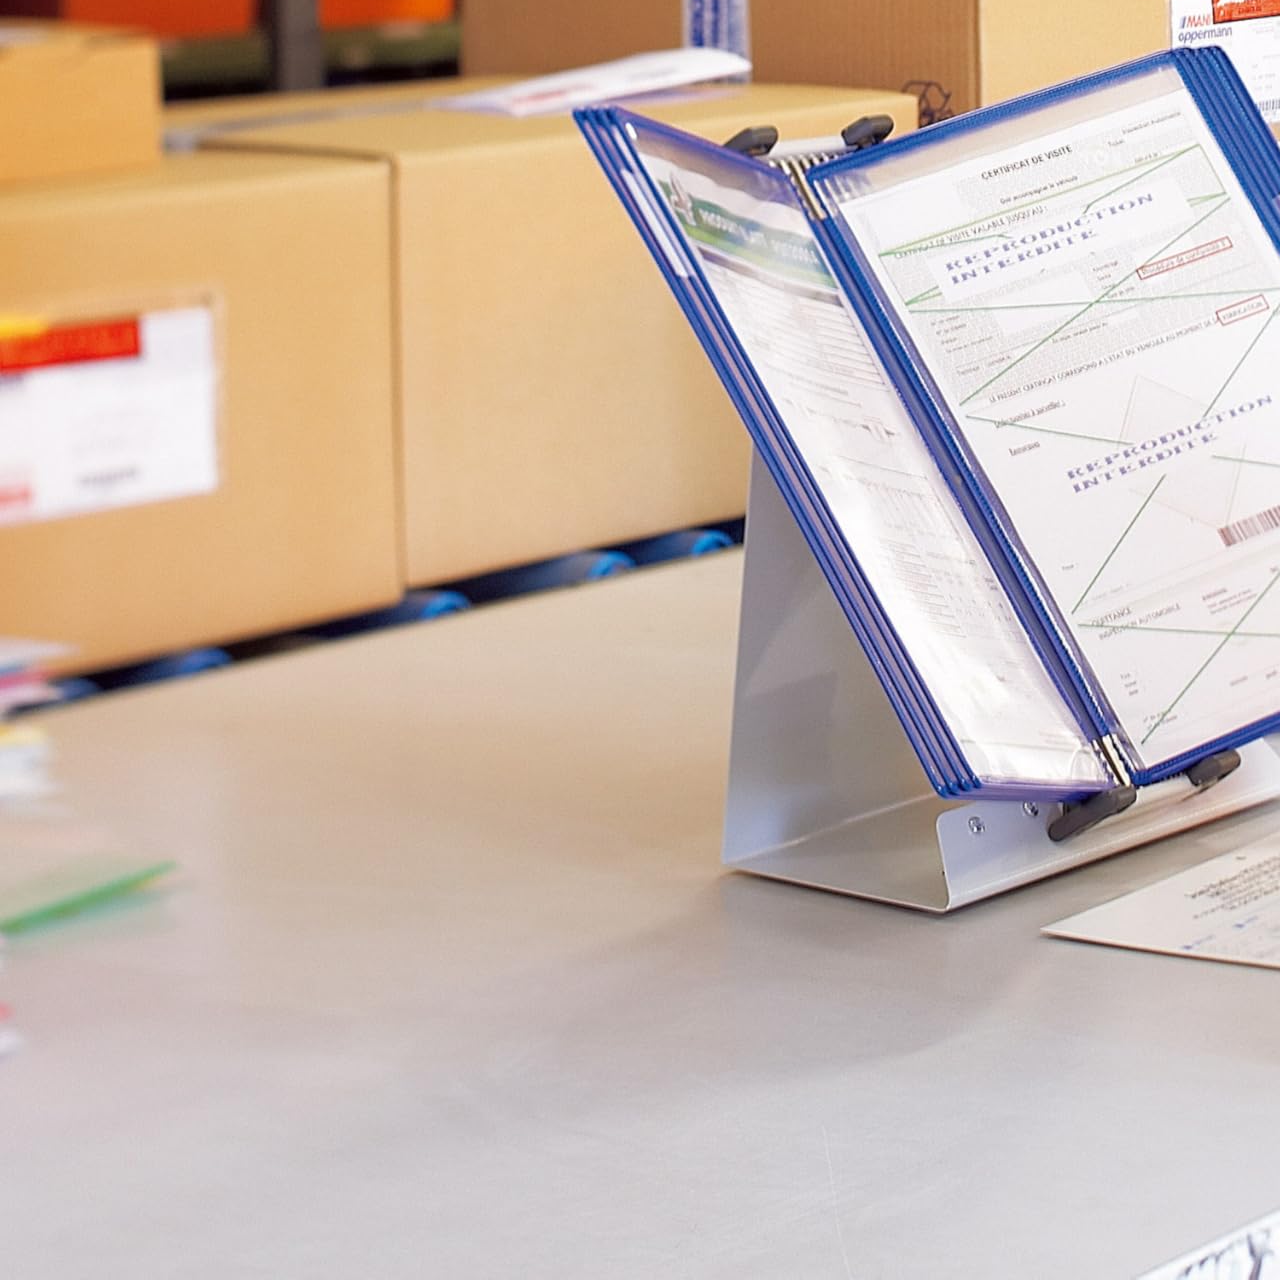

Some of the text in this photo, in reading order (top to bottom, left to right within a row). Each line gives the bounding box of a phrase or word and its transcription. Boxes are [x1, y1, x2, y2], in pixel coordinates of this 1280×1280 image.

[1178, 27, 1232, 43] oppermann
[981, 144, 1073, 180] CERTIFICAT DE VISITE
[946, 230, 970, 243] VISITE
[970, 218, 1005, 237] VALABLE
[946, 193, 1152, 272] REPRODUCTION
[951, 230, 1097, 285] INTERDITE
[1067, 394, 1272, 480] REPRODUCTION
[1072, 432, 1218, 494] INTERDITE
